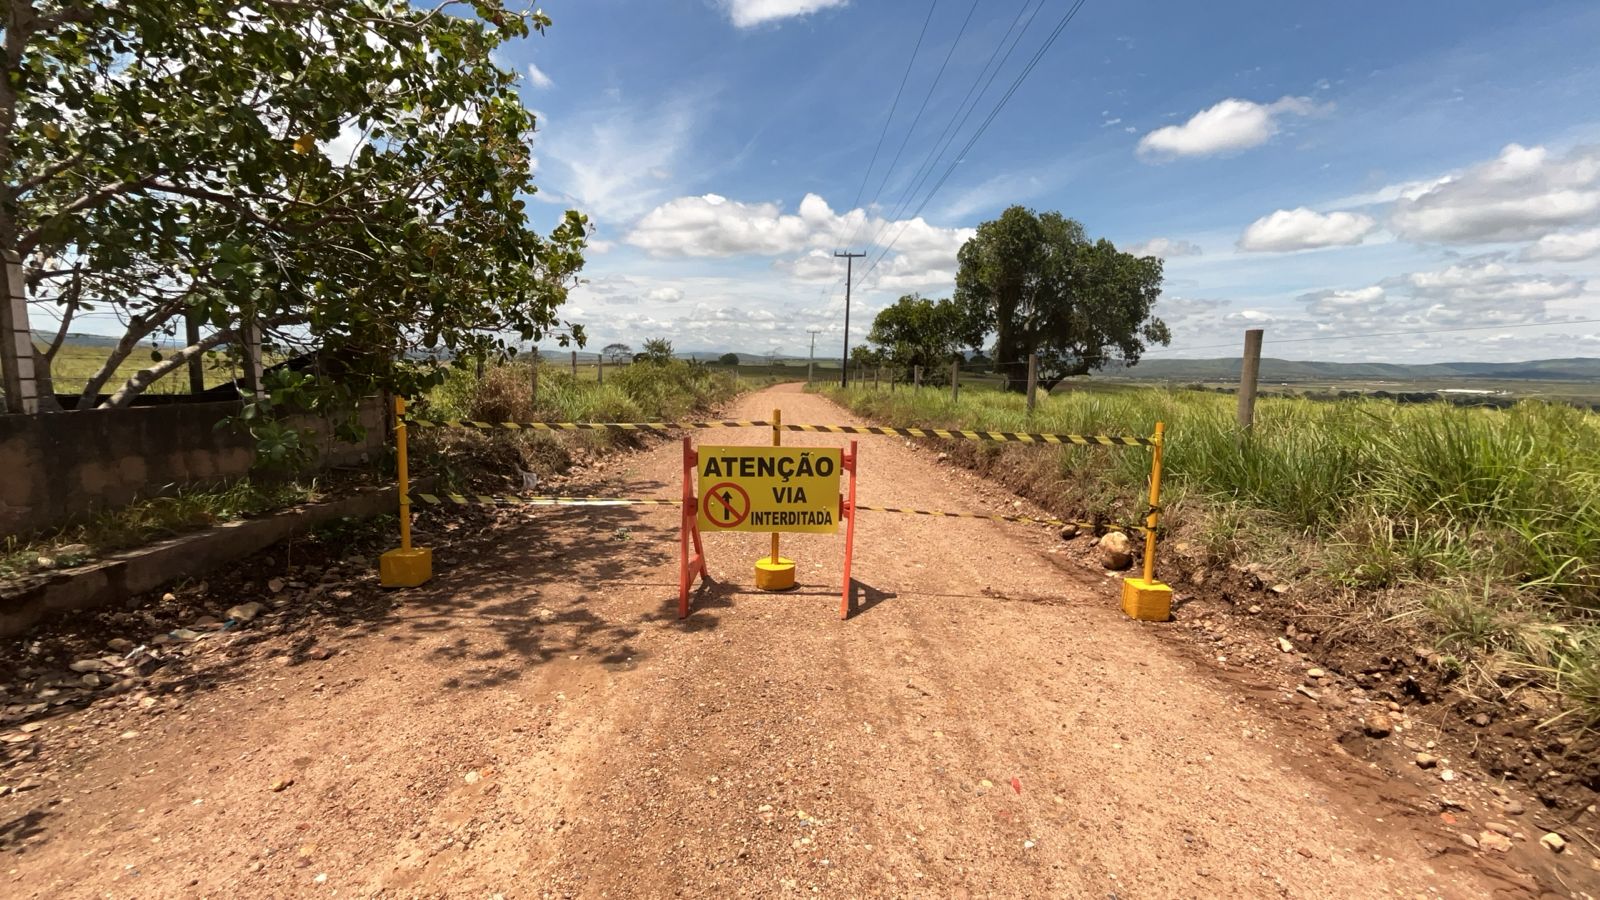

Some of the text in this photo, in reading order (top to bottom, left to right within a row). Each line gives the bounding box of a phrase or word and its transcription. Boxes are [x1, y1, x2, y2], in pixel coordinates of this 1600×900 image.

[703, 452, 834, 483] ATENÇÃO
[772, 487, 807, 504] VIA
[751, 511, 832, 526] INTERDITADA
